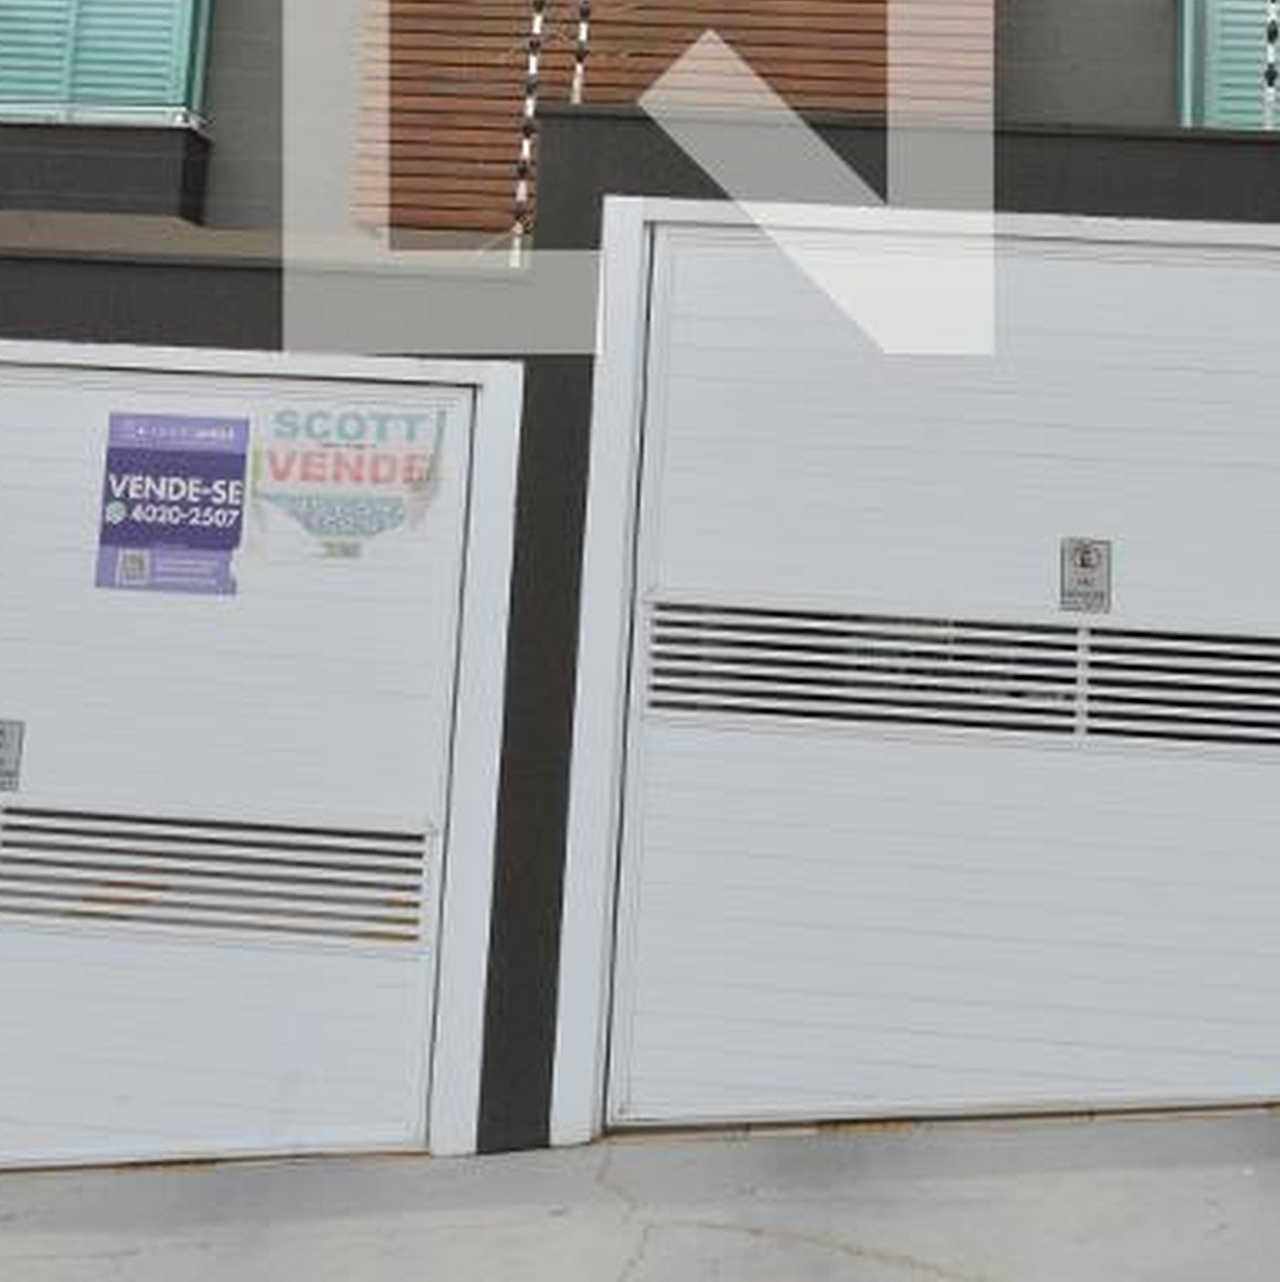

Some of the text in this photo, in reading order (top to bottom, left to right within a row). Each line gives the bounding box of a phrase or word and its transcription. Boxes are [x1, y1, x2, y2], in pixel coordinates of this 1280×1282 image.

[274, 409, 430, 442] SCOTT
[268, 450, 429, 484] VENDE
[108, 473, 243, 506] VENDE-SE
[131, 504, 240, 527] 4020-2507
